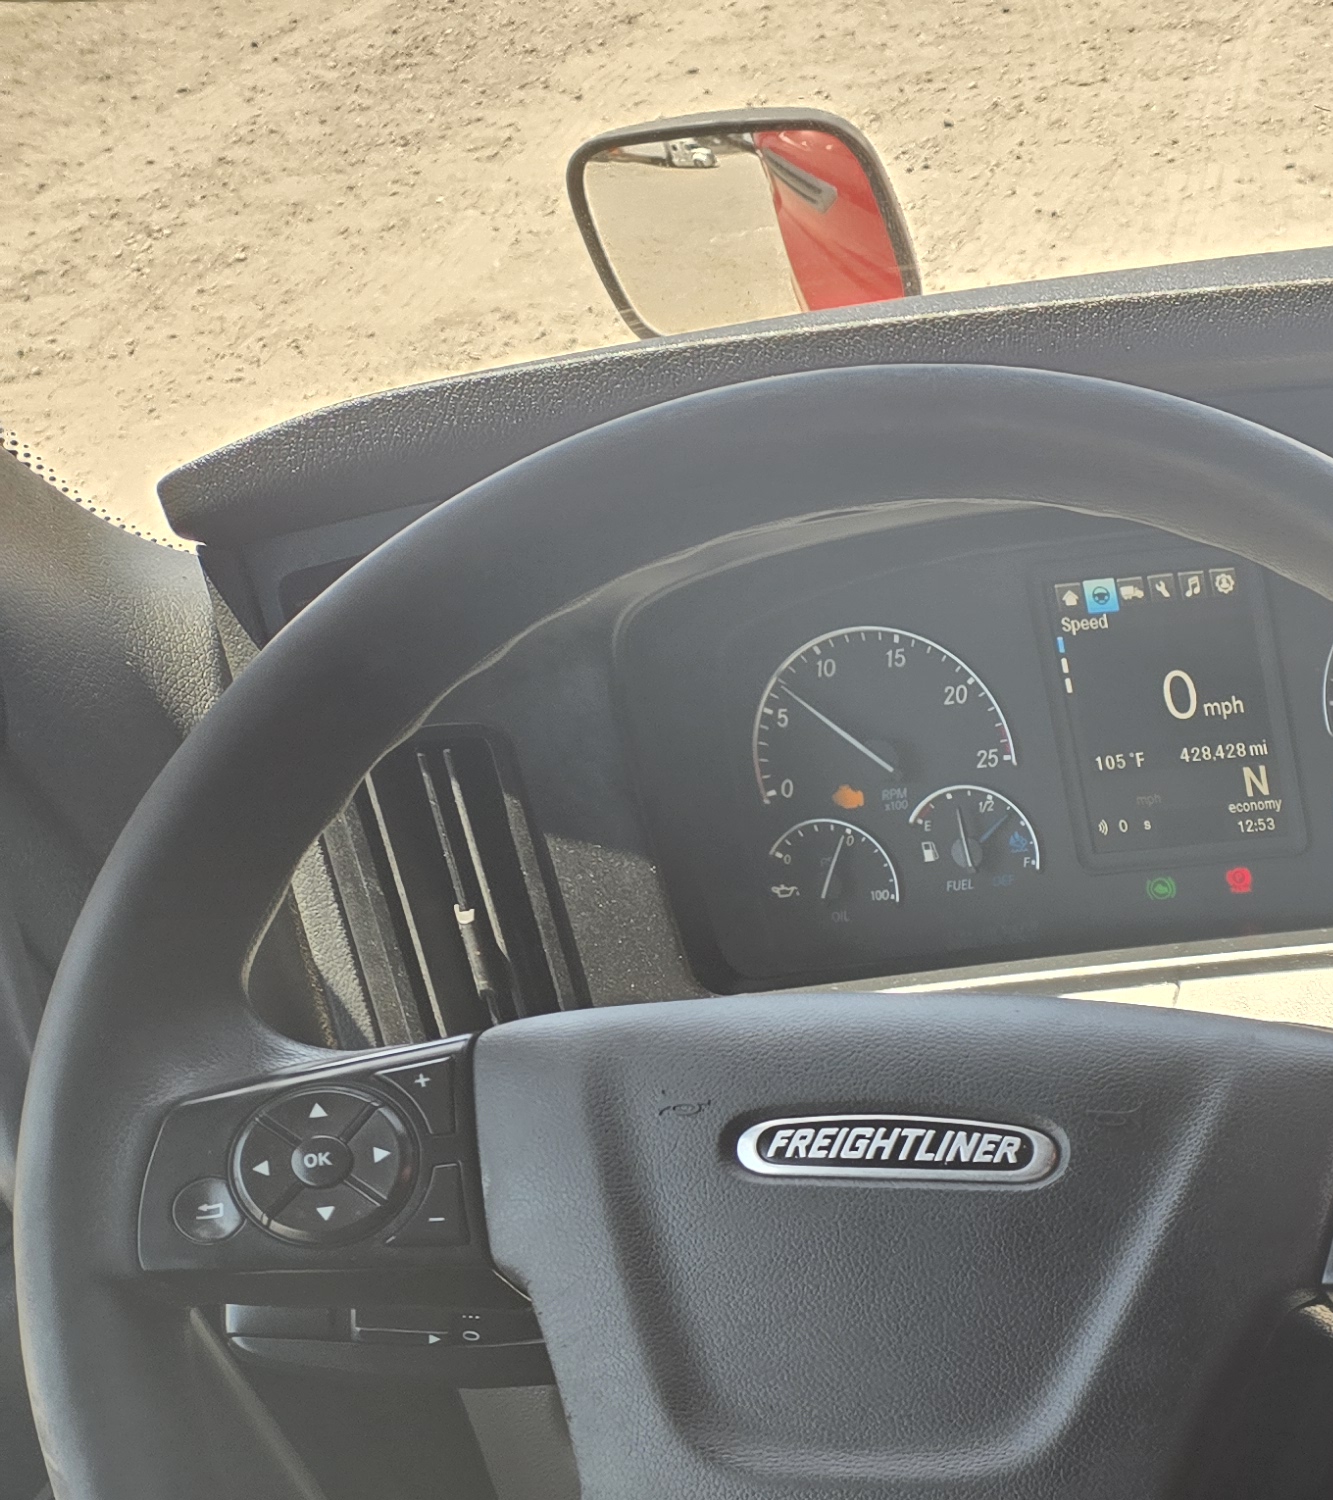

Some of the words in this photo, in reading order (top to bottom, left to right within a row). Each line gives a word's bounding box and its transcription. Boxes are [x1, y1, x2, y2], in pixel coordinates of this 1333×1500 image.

[1061, 614, 1109, 635] Speed
[886, 648, 906, 668] 15
[817, 659, 836, 678] 10
[944, 685, 967, 705] 20
[1163, 669, 1197, 720] 0
[1203, 695, 1245, 720] mph
[777, 708, 789, 728] 5
[1249, 739, 1268, 757] mi
[976, 749, 999, 768] 25
[1095, 754, 1126, 771] 105
[1129, 752, 1145, 768] °F
[781, 779, 793, 798] 0
[1242, 765, 1270, 797] N
[882, 788, 908, 801] RPM
[884, 800, 909, 811] x100
[978, 801, 994, 813] 1/2
[1228, 798, 1282, 813] economy
[924, 820, 931, 832] E
[1119, 819, 1128, 833] 0
[1237, 818, 1276, 834] 12:53
[783, 854, 792, 865] 0
[1023, 857, 1031, 868] F
[946, 879, 974, 892] FUEL
[870, 890, 890, 901] 100
[766, 1126, 1021, 1165] FREIGHTLINER
[303, 1150, 332, 1169] OK
